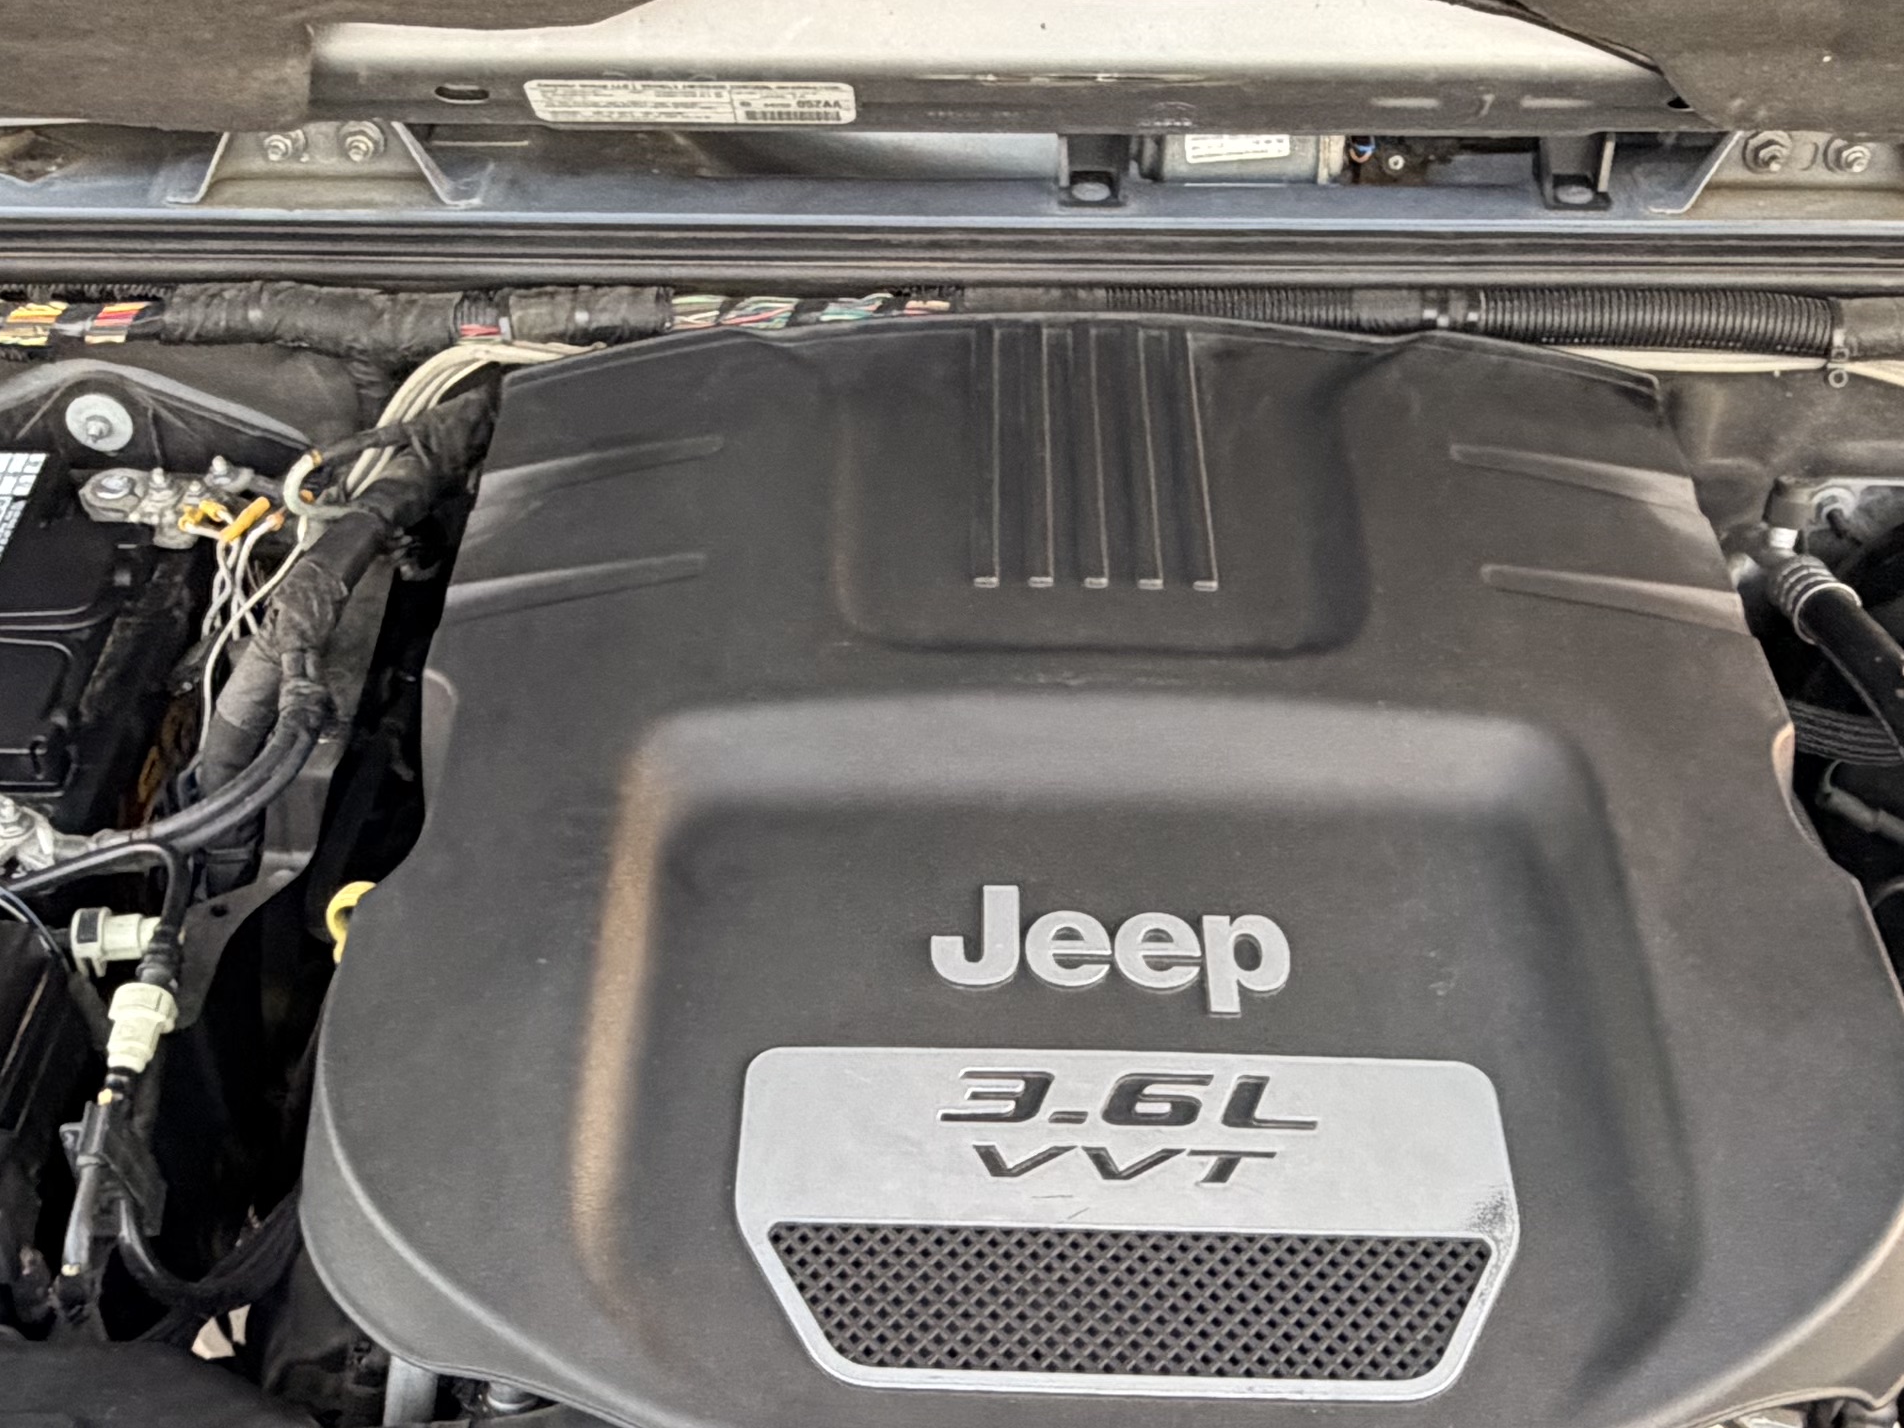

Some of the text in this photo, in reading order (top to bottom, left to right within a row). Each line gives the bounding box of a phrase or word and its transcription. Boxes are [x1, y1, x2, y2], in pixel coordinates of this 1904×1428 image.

[929, 883, 1292, 1016] Jeep
[937, 1067, 1319, 1130] 3.6L
[971, 1143, 1278, 1185] VVT
